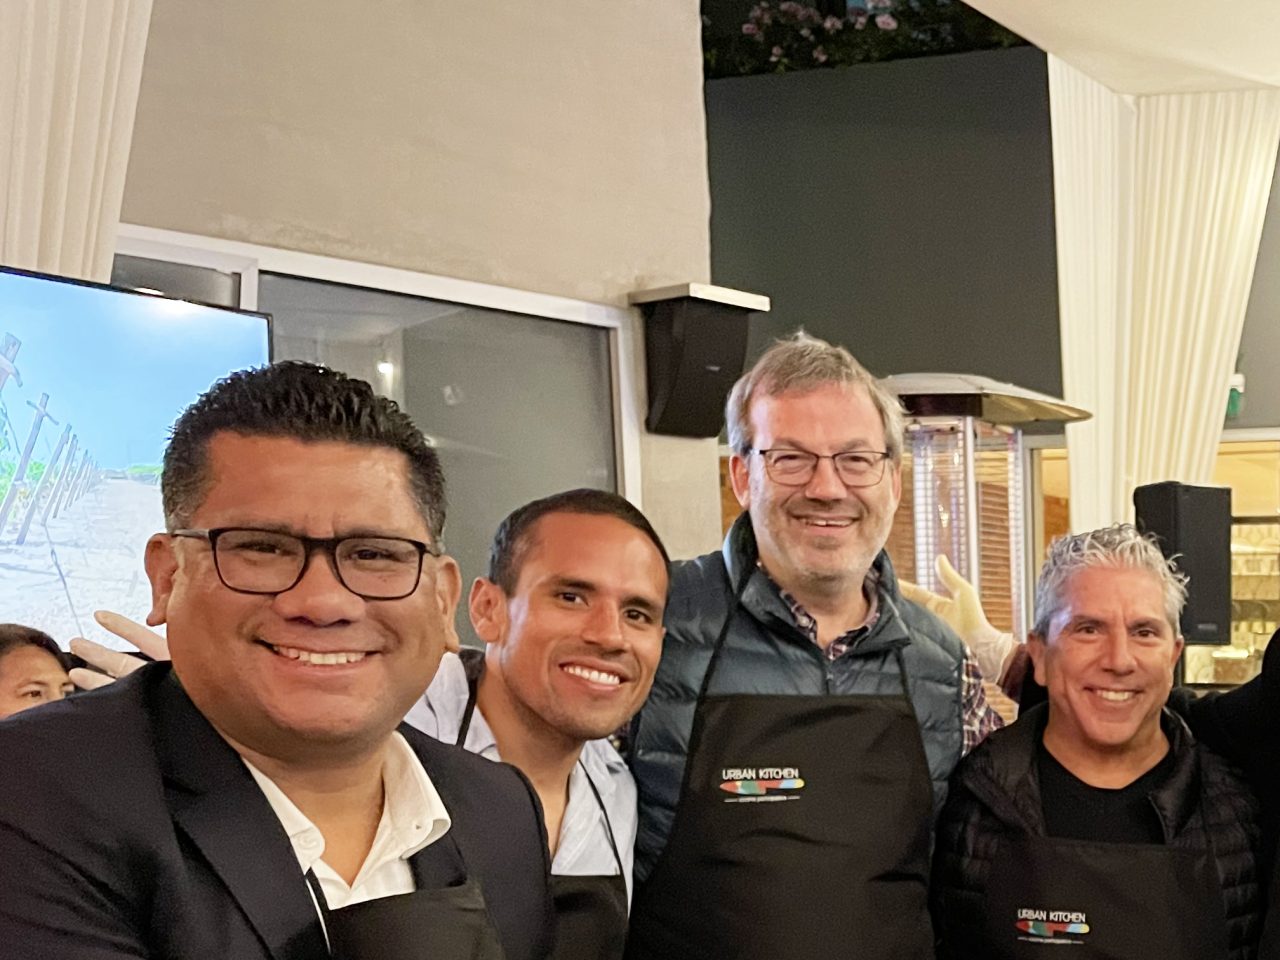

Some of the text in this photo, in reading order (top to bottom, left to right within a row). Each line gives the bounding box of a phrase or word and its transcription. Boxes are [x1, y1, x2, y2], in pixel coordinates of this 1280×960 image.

[722, 767, 799, 780] URBAN KITCHEN
[1017, 908, 1086, 923] URBAN KITCHEN
